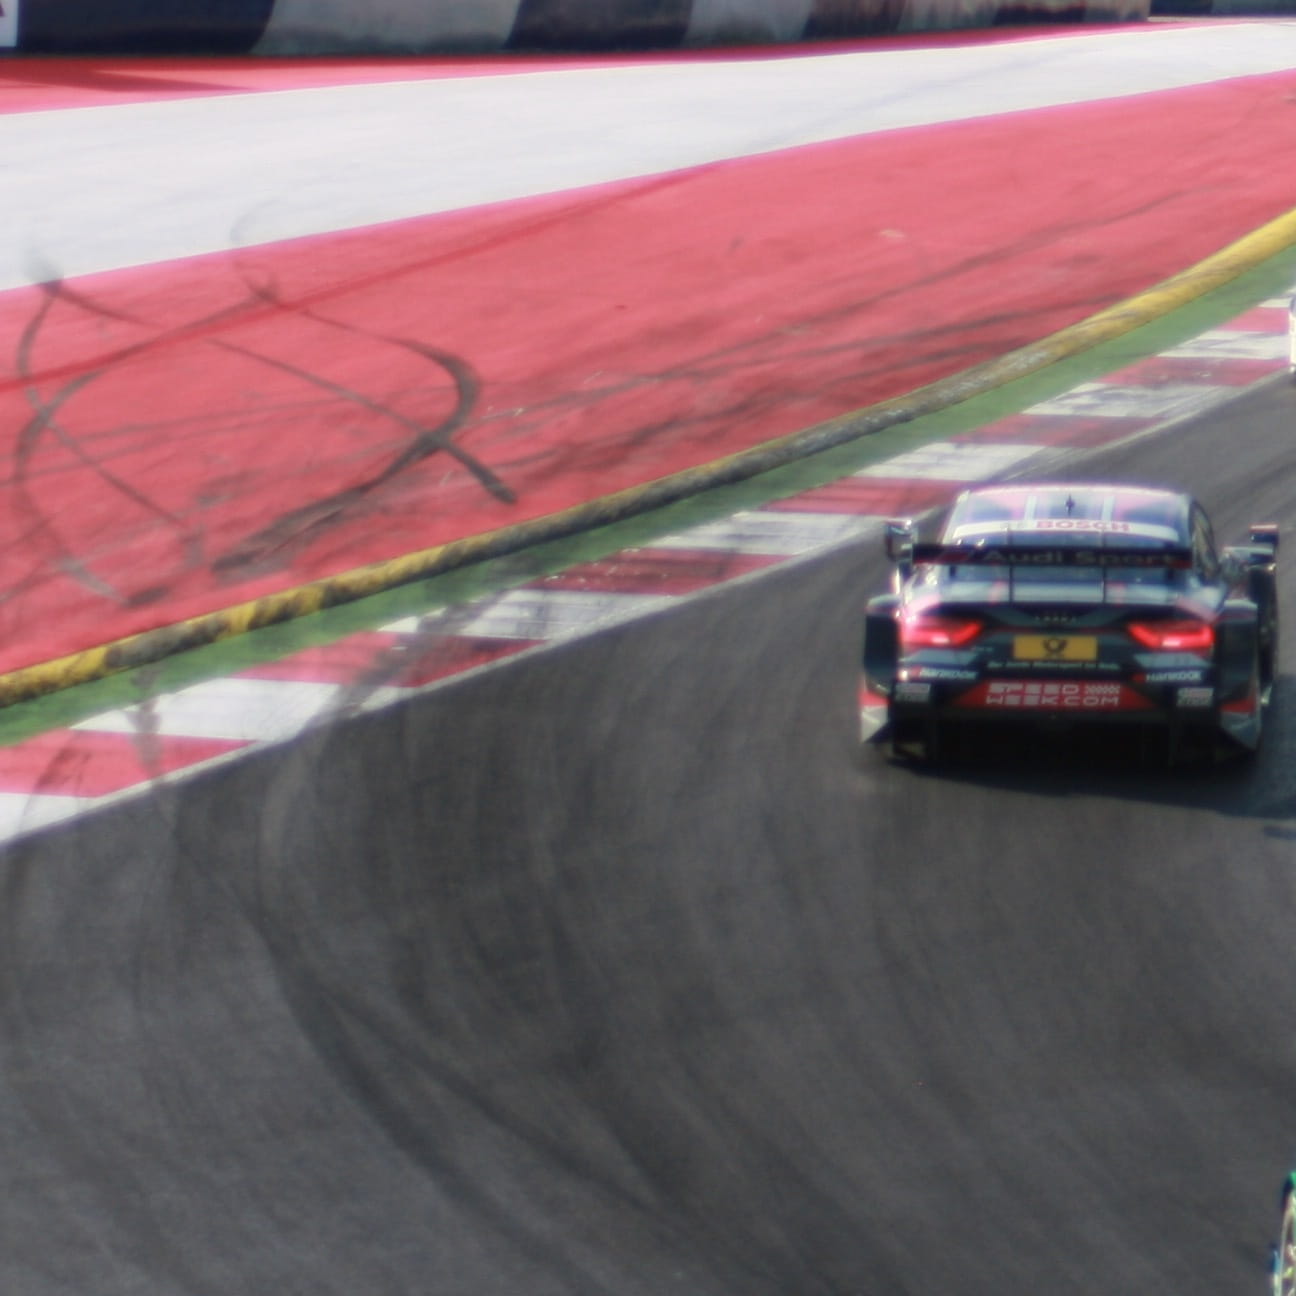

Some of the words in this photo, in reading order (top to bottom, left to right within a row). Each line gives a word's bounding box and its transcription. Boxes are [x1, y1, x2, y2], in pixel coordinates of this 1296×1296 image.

[1036, 519, 1131, 533] BOSCH
[982, 550, 1063, 565] Audi
[1075, 550, 1178, 568] Sport
